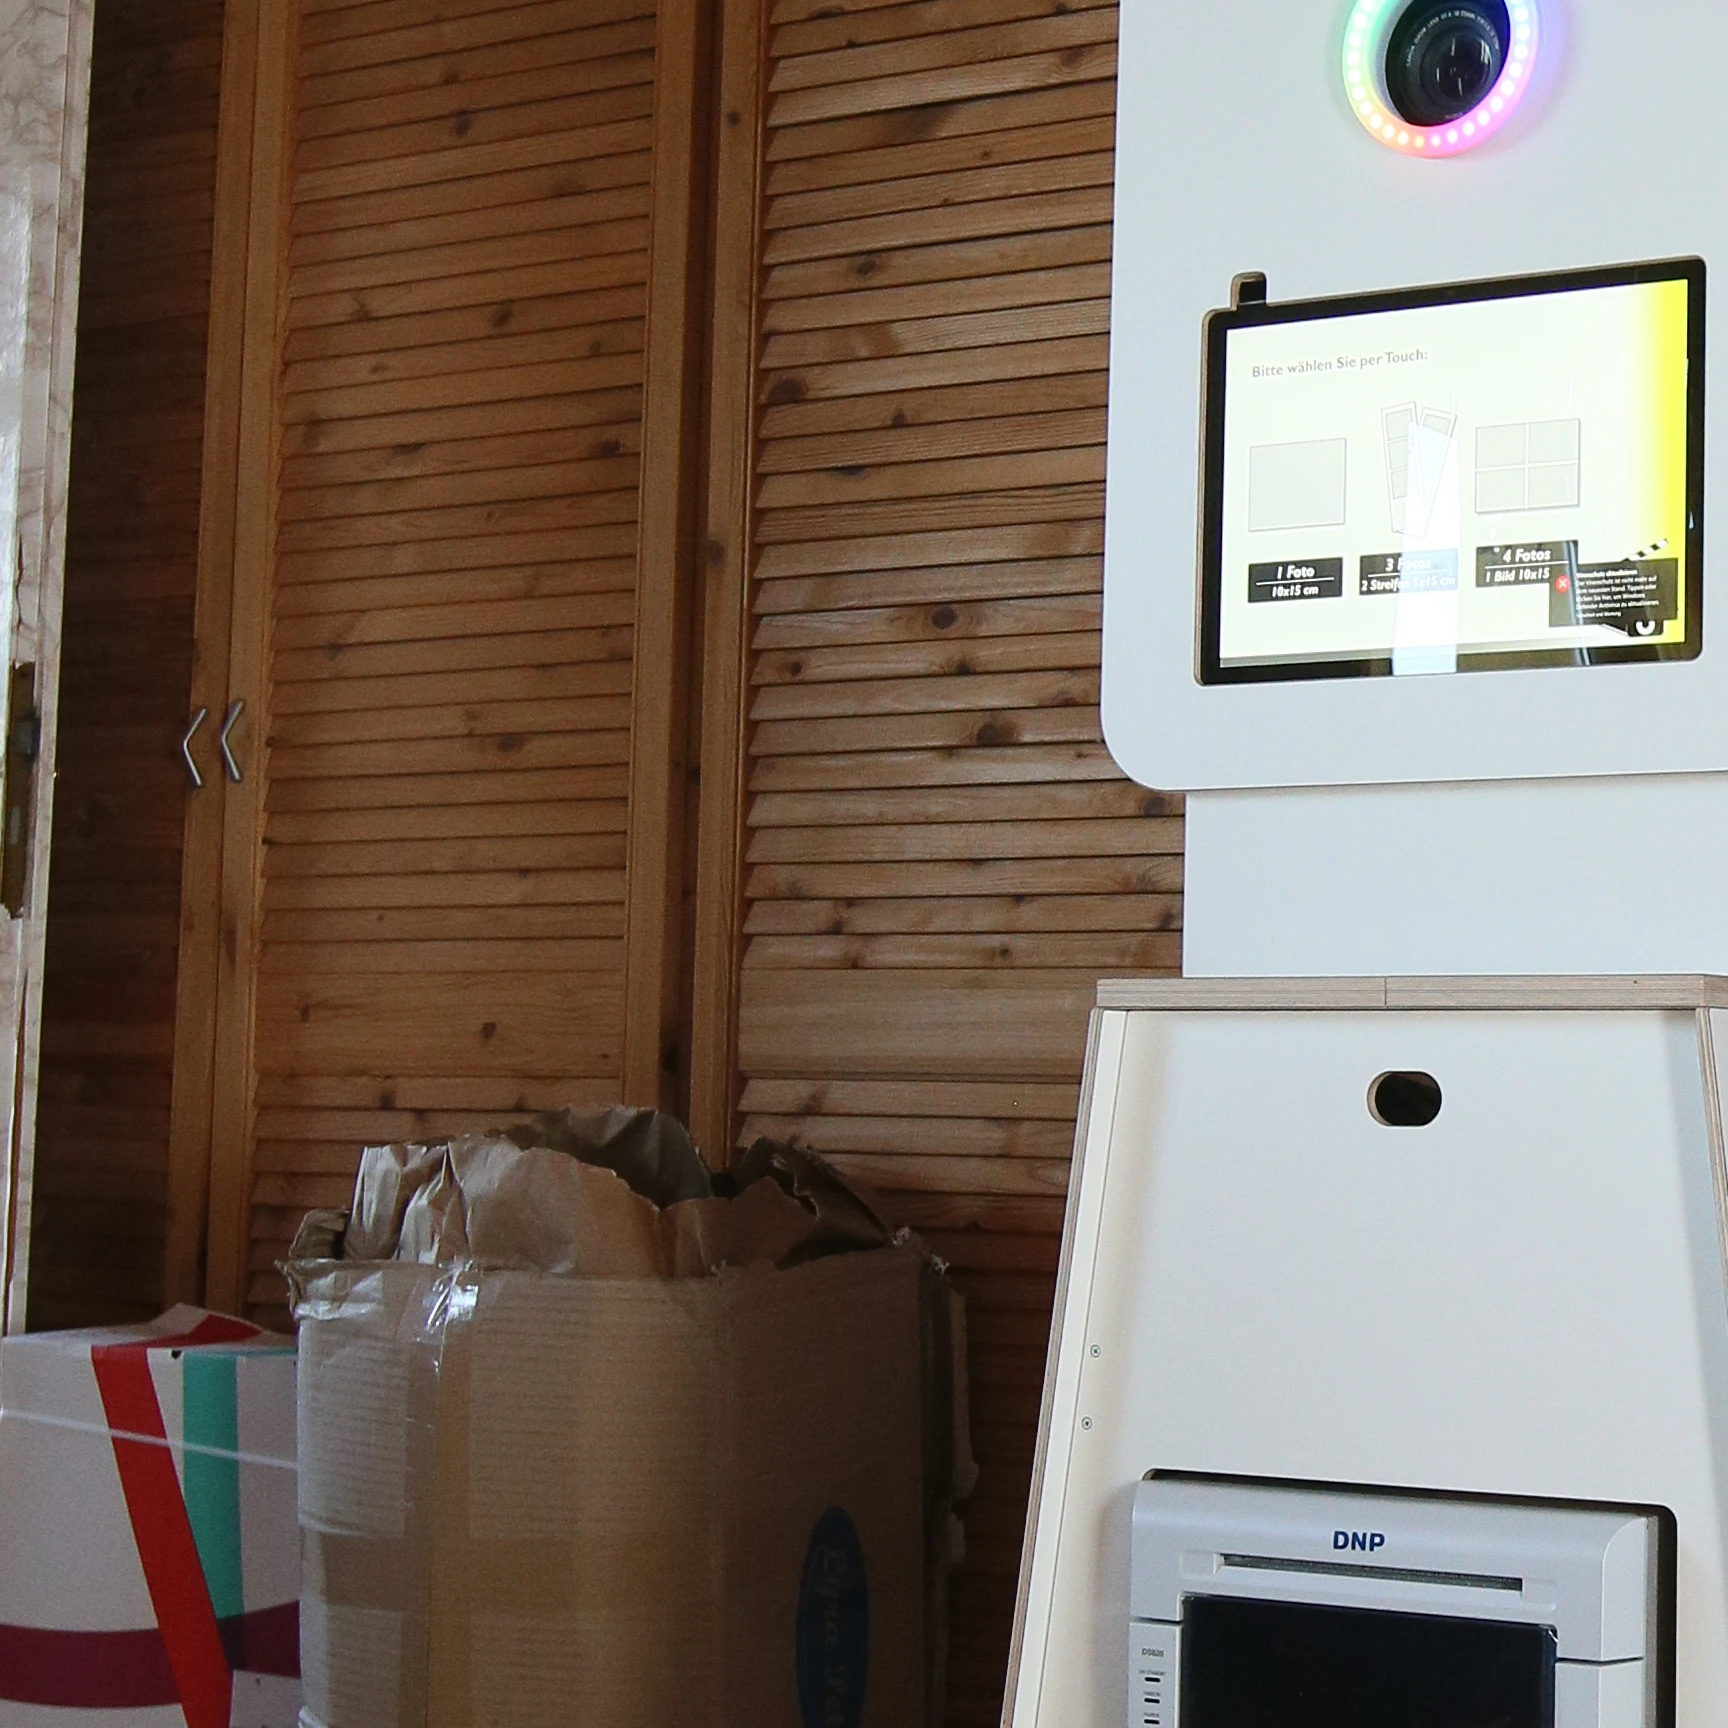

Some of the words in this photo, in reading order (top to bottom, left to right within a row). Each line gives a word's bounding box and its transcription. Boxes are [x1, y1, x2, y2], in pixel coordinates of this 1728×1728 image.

[1252, 365, 1284, 378] Bitte
[1287, 359, 1333, 374] wählen
[1336, 355, 1356, 369] Sie
[1359, 355, 1382, 370] per
[1384, 348, 1428, 364] Touch:
[1503, 549, 1512, 563] 4
[1515, 547, 1551, 563] Fotos
[1385, 557, 1394, 571] 3
[1397, 556, 1433, 570] Fotos
[1277, 566, 1283, 580] 1
[1287, 564, 1316, 579] Foto
[1485, 571, 1491, 583] 1
[1494, 568, 1516, 582] Bild
[1518, 567, 1550, 581] 10x15
[1271, 584, 1301, 598] 10x15
[1303, 584, 1320, 597] cm
[1361, 580, 1368, 592] 2
[1370, 577, 1410, 591] Streifen
[1333, 1530, 1385, 1552] DNP
